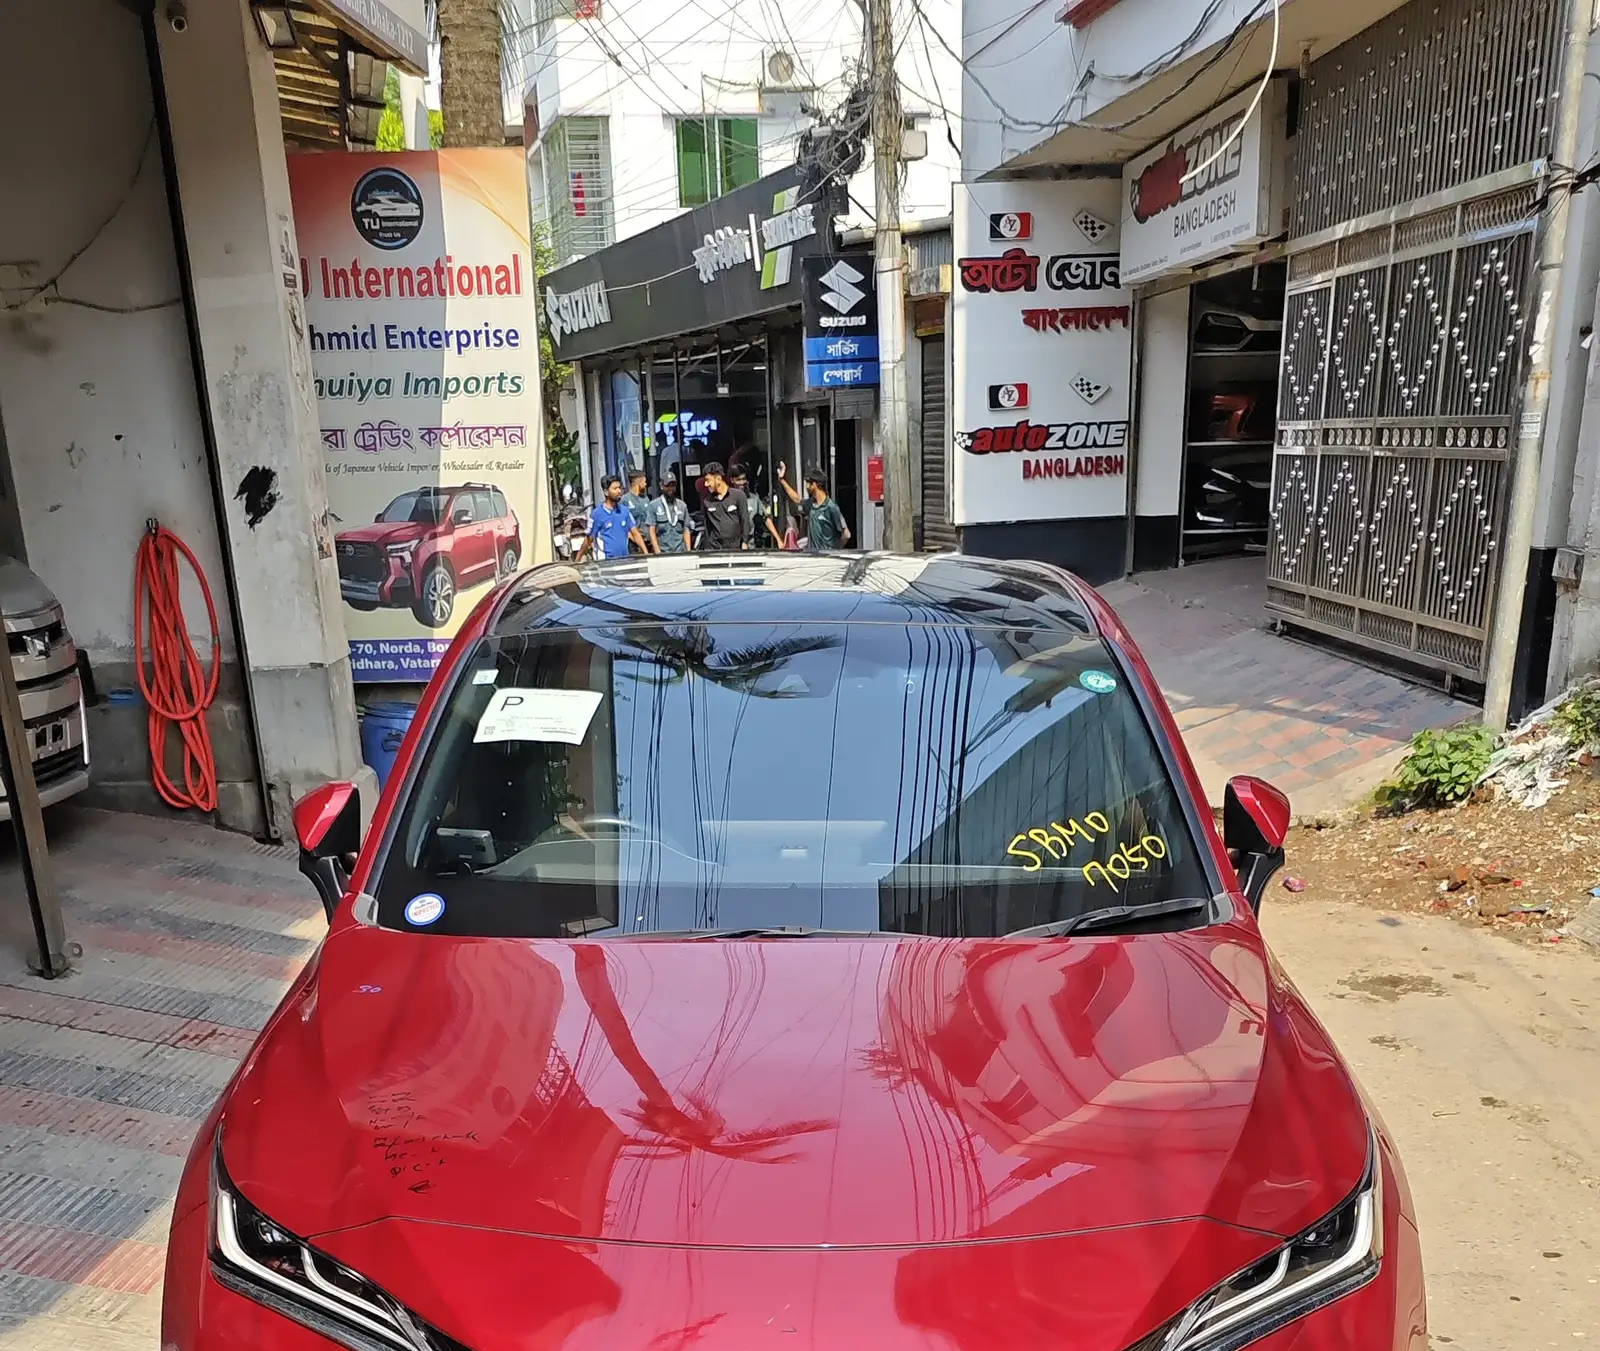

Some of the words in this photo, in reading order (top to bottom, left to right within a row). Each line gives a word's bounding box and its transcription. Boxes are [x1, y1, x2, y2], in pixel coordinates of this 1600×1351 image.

[362, 217, 380, 230] TU
[1173, 190, 1237, 238] BANGLADESH
[320, 253, 522, 299] International
[959, 248, 1040, 292] অটো
[1047, 252, 1121, 291] জোন
[559, 280, 612, 335] SUZUKI
[1021, 306, 1130, 334] বাংলাদেশ
[819, 315, 867, 328] SUZUKI
[309, 324, 377, 350] hmid
[384, 322, 520, 355] Enterprise
[826, 339, 859, 357] সার্ভিস
[314, 371, 392, 402] huiya
[402, 371, 523, 401] Imports
[320, 428, 346, 449] রা
[354, 420, 414, 451] ট্রেডিং
[333, 463, 342, 474] of
[343, 463, 375, 475] Japanese
[377, 462, 405, 472] Vehicle
[443, 461, 484, 471] Wholesaler
[495, 460, 525, 471] Retailer
[1022, 455, 1124, 480] BANGLADESH
[348, 643, 377, 656] -70,
[380, 642, 424, 654] Norda,
[350, 659, 399, 670] idhara,
[500, 696, 524, 712] P
